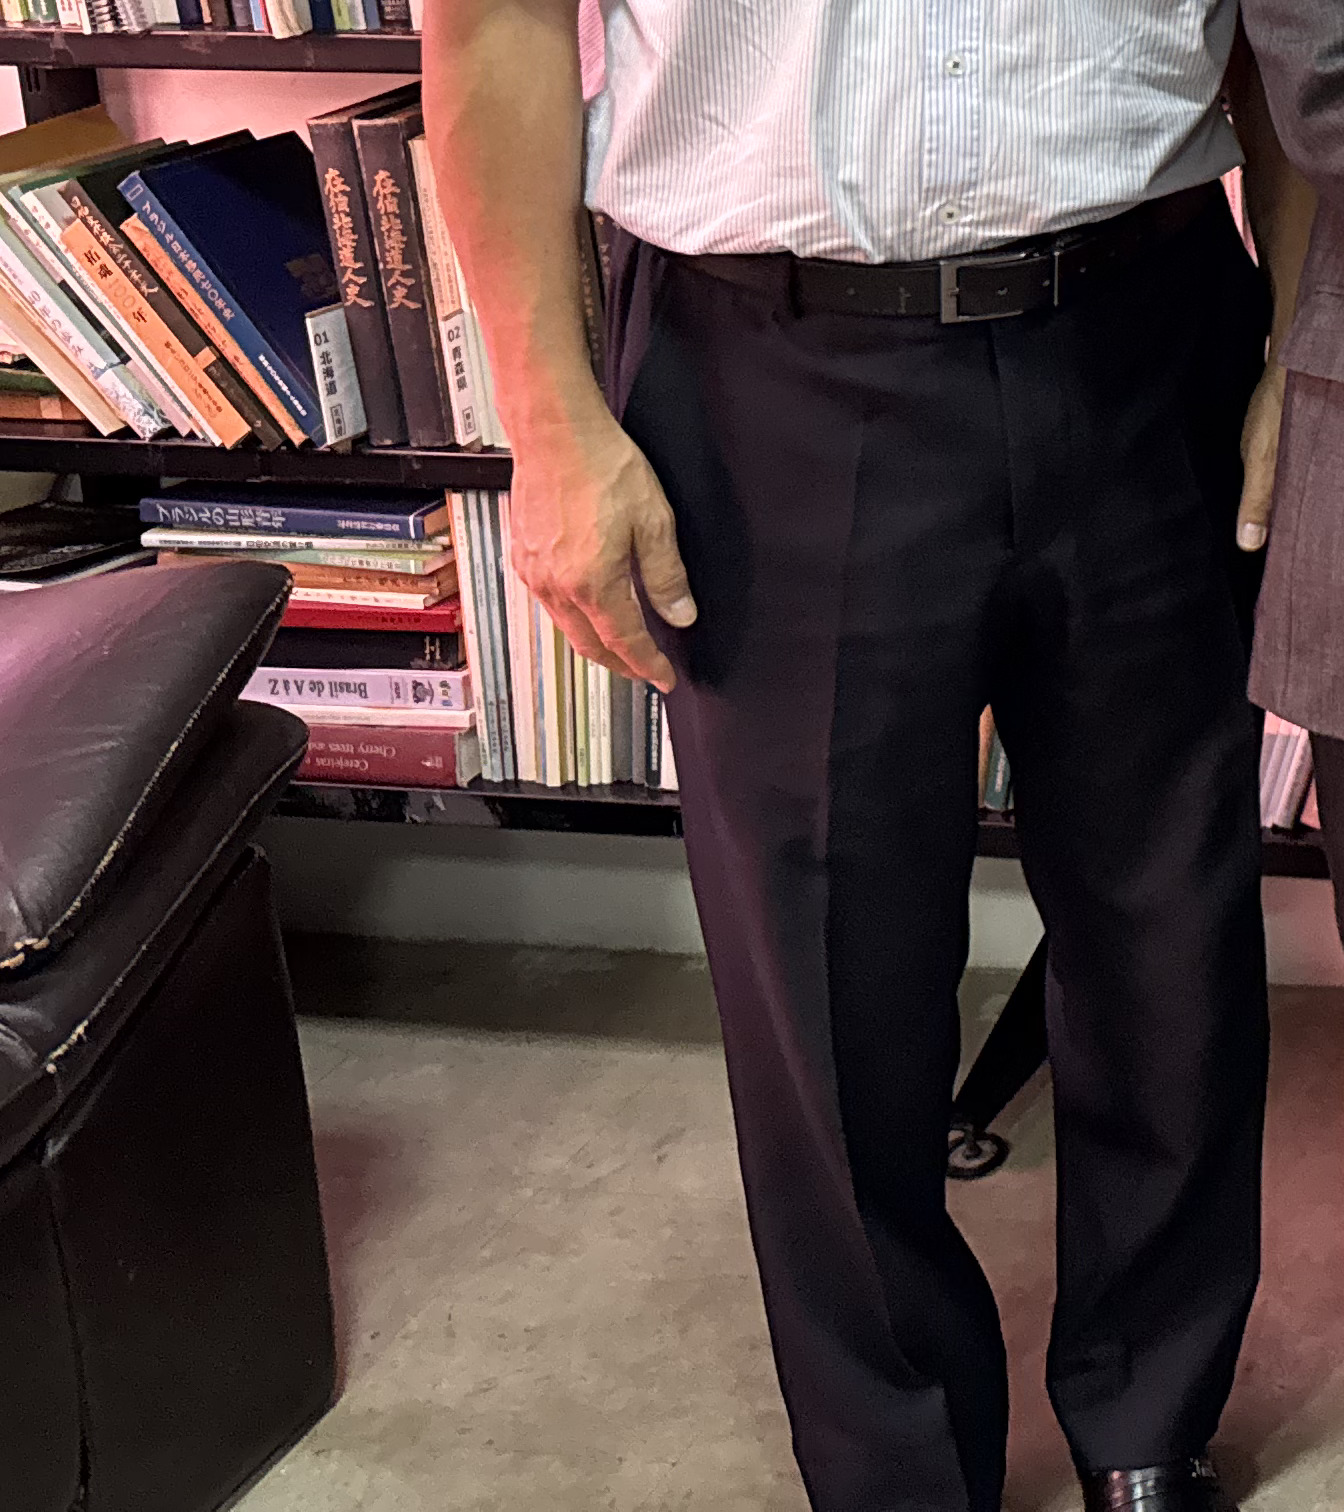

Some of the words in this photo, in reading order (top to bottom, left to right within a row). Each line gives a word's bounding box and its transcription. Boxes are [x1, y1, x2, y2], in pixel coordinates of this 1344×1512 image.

[314, 331, 330, 345] 01
[448, 326, 461, 342] 02
[320, 350, 338, 396] 北海道
[269, 679, 280, 694] Z
[284, 679, 291, 694] à
[295, 680, 303, 694] A
[310, 681, 325, 694] de
[327, 680, 368, 699] Brasil
[359, 743, 396, 757] Cherry
